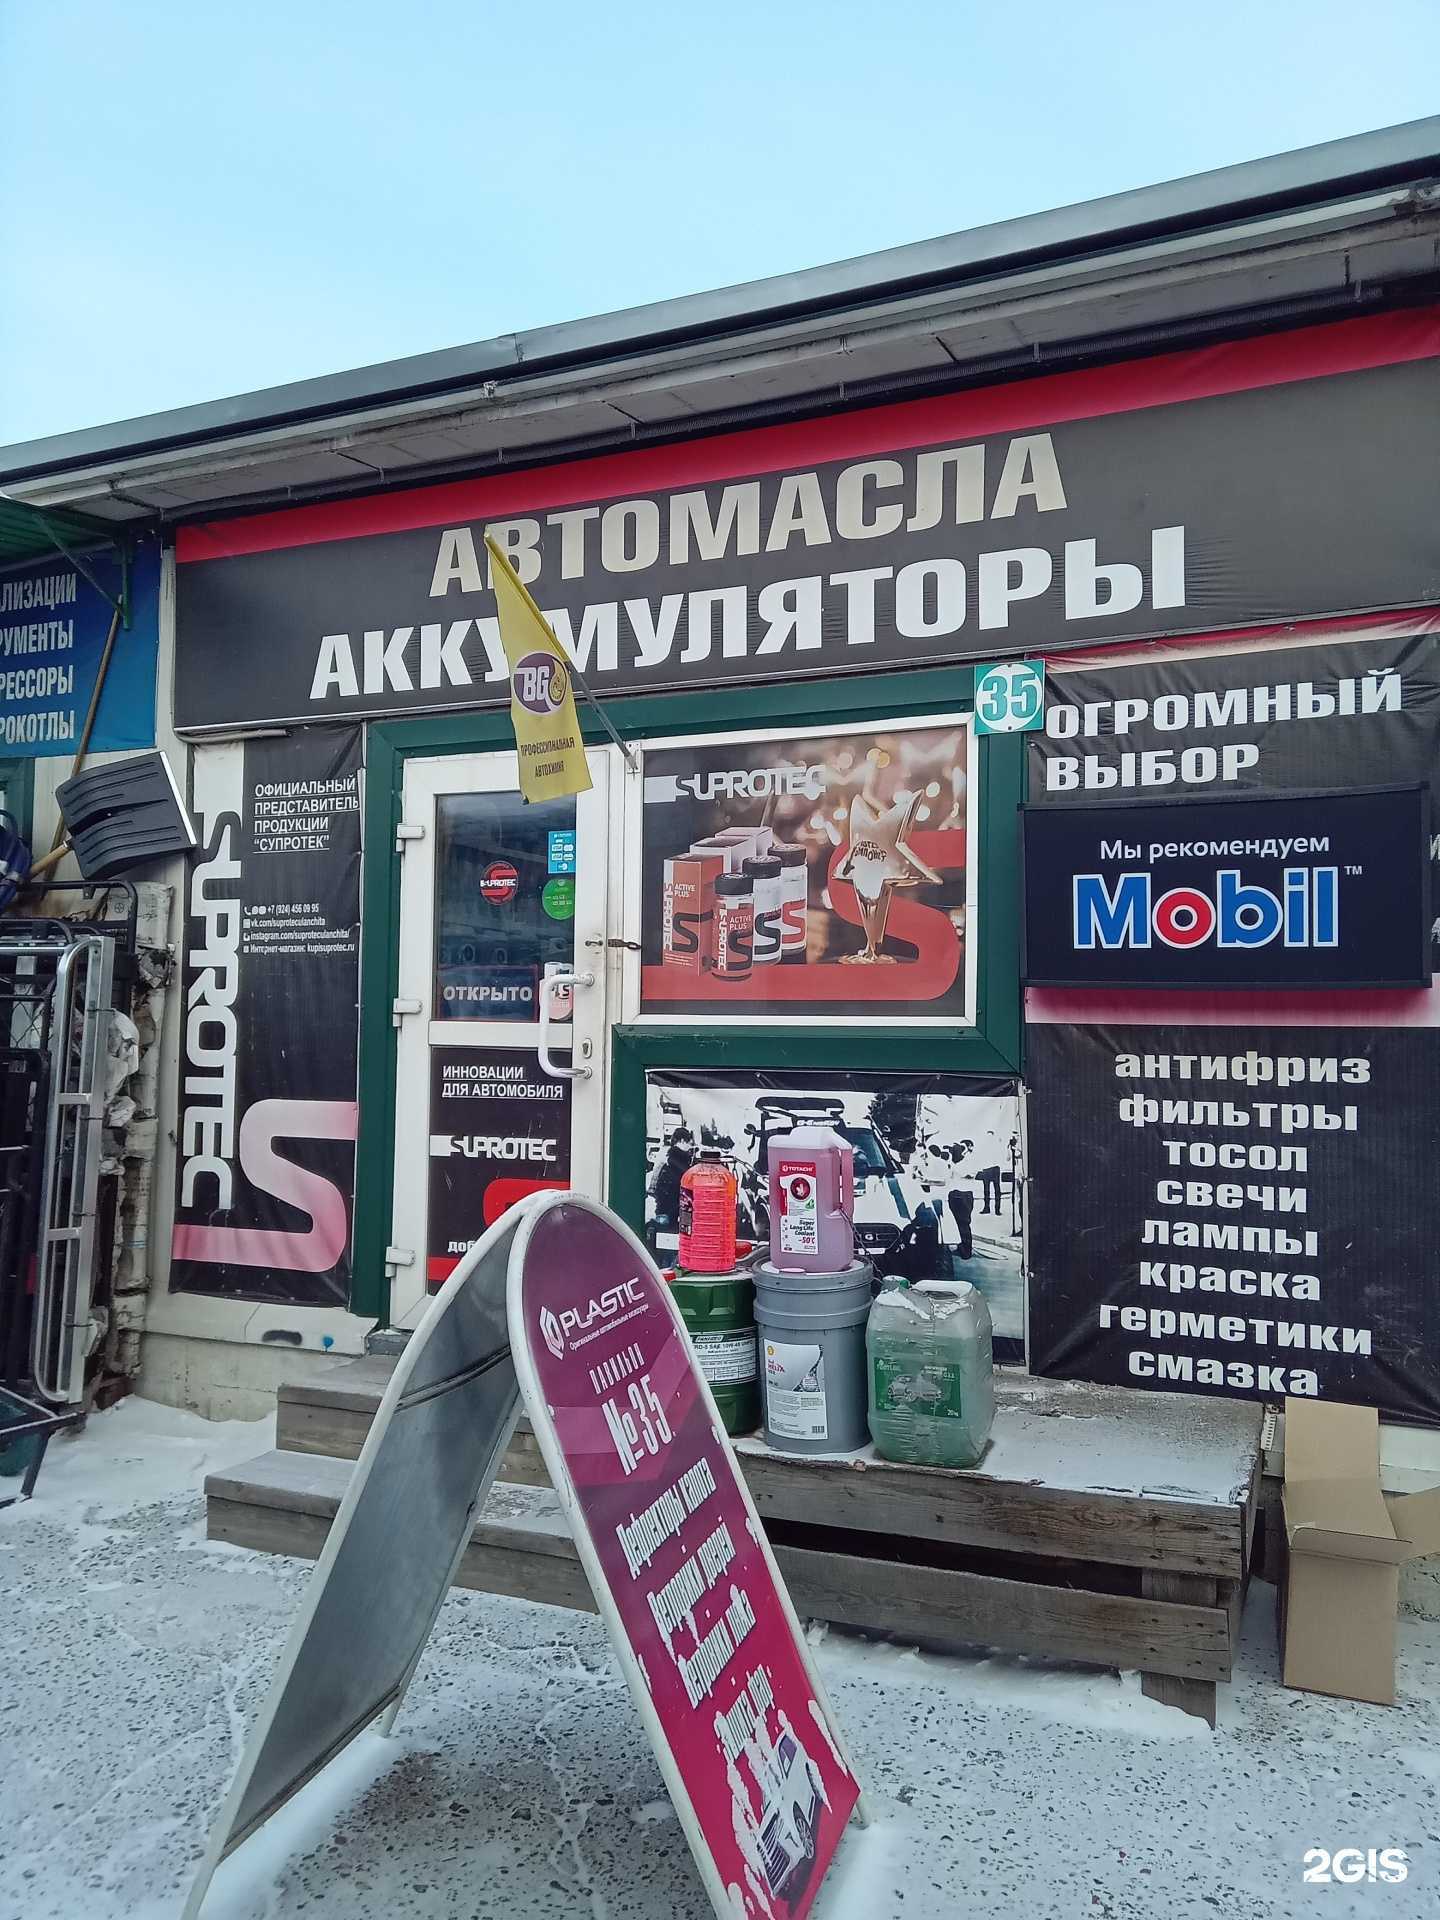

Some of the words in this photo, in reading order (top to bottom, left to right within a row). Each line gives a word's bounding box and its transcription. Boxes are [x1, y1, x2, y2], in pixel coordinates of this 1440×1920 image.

[429, 432, 1068, 598] АВТОМАСЛА
[982, 674, 1039, 722] 35
[1045, 668, 1402, 739] ОГРОМНЫЙ
[521, 736, 575, 757] ПРОФЕССИОНАЛЬНАЯ
[255, 774, 356, 797] ОФИЦИАЛЬНЫЙ
[535, 761, 564, 778] АВТОХИМИЯ
[676, 764, 826, 800] SUPROTEC
[1045, 744, 1260, 791] ВЫБОР
[254, 797, 359, 816] ПРЕДСТАВИТЕЛЬ
[254, 817, 329, 833] ПРОДУКЦИИ
[1100, 840, 1142, 860] Мы
[1148, 837, 1330, 864] рекомендуем
[1072, 866, 1339, 949] Mobil
[181, 811, 243, 1210] SUPROTEC
[442, 985, 533, 1001] ОТКРЫТО
[442, 1065, 524, 1080] ИННОВАЦИИ
[1114, 1051, 1371, 1086] антифриз
[442, 1083, 469, 1098] ДЛЯ
[472, 1084, 563, 1099] АВТОМОБИЛЯ
[1119, 1093, 1358, 1133] фильтры
[450, 1135, 557, 1161] SUPROTEC
[1163, 1140, 1308, 1172] тосол
[1156, 1180, 1307, 1213] свечи
[1141, 1219, 1318, 1256] лампы
[1140, 1261, 1321, 1300] краска
[559, 1277, 646, 1337] PLASTIC
[1099, 1304, 1372, 1355] герметики
[589, 1342, 645, 1395] ПАВИЛЬОН
[1128, 1350, 1319, 1396] смазка
[615, 1484, 687, 1580] Дефлекторы
[678, 1457, 717, 1514] капота
[646, 1555, 707, 1632] Ветровики
[697, 1515, 736, 1589] дверей
[677, 1617, 735, 1710] Ветровики
